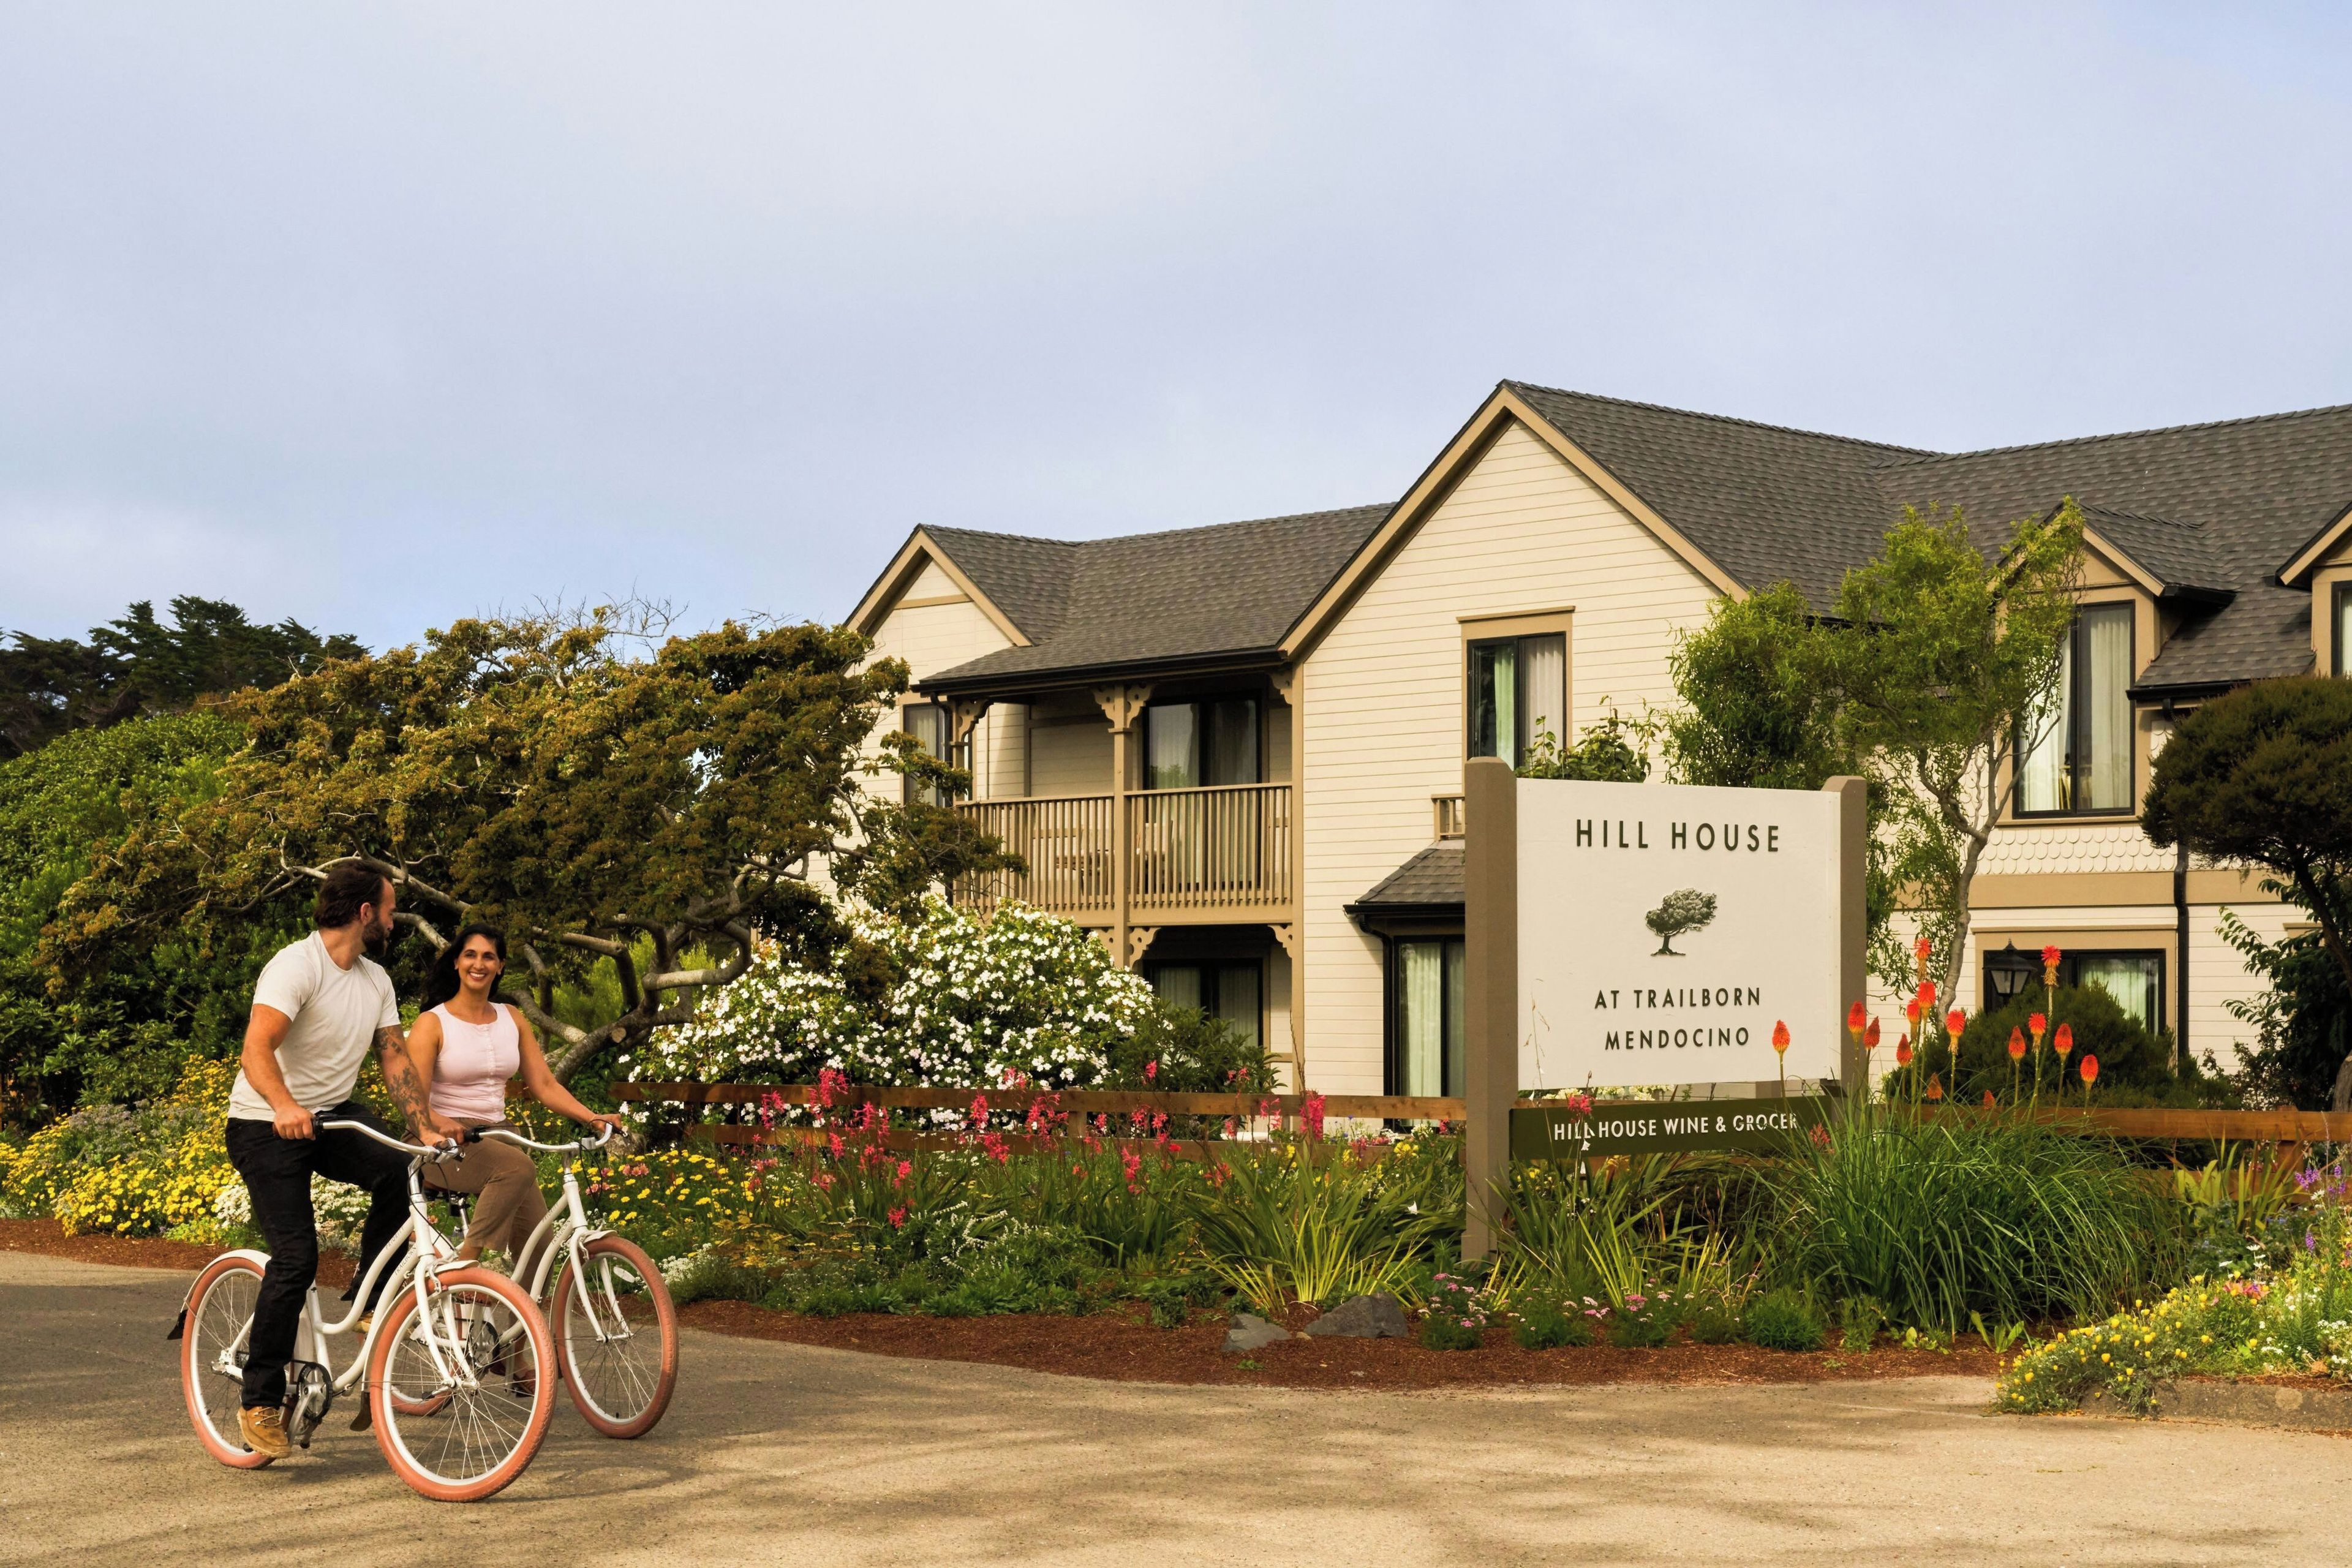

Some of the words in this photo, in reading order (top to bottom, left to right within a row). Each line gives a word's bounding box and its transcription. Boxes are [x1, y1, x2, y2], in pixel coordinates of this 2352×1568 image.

[1576, 818, 1649, 849] HILL
[1671, 821, 1779, 853] HOUSE
[1594, 989, 1620, 1009] AT
[1633, 987, 1760, 1009] TRAILBORN
[1604, 1027, 1749, 1050] MENDOCINO
[1554, 1122, 1591, 1140] HILL
[1598, 1119, 1657, 1138] HOUSE
[1663, 1117, 1709, 1136] WINE
[1715, 1115, 1727, 1133] &
[1733, 1112, 1798, 1132] GROCER
